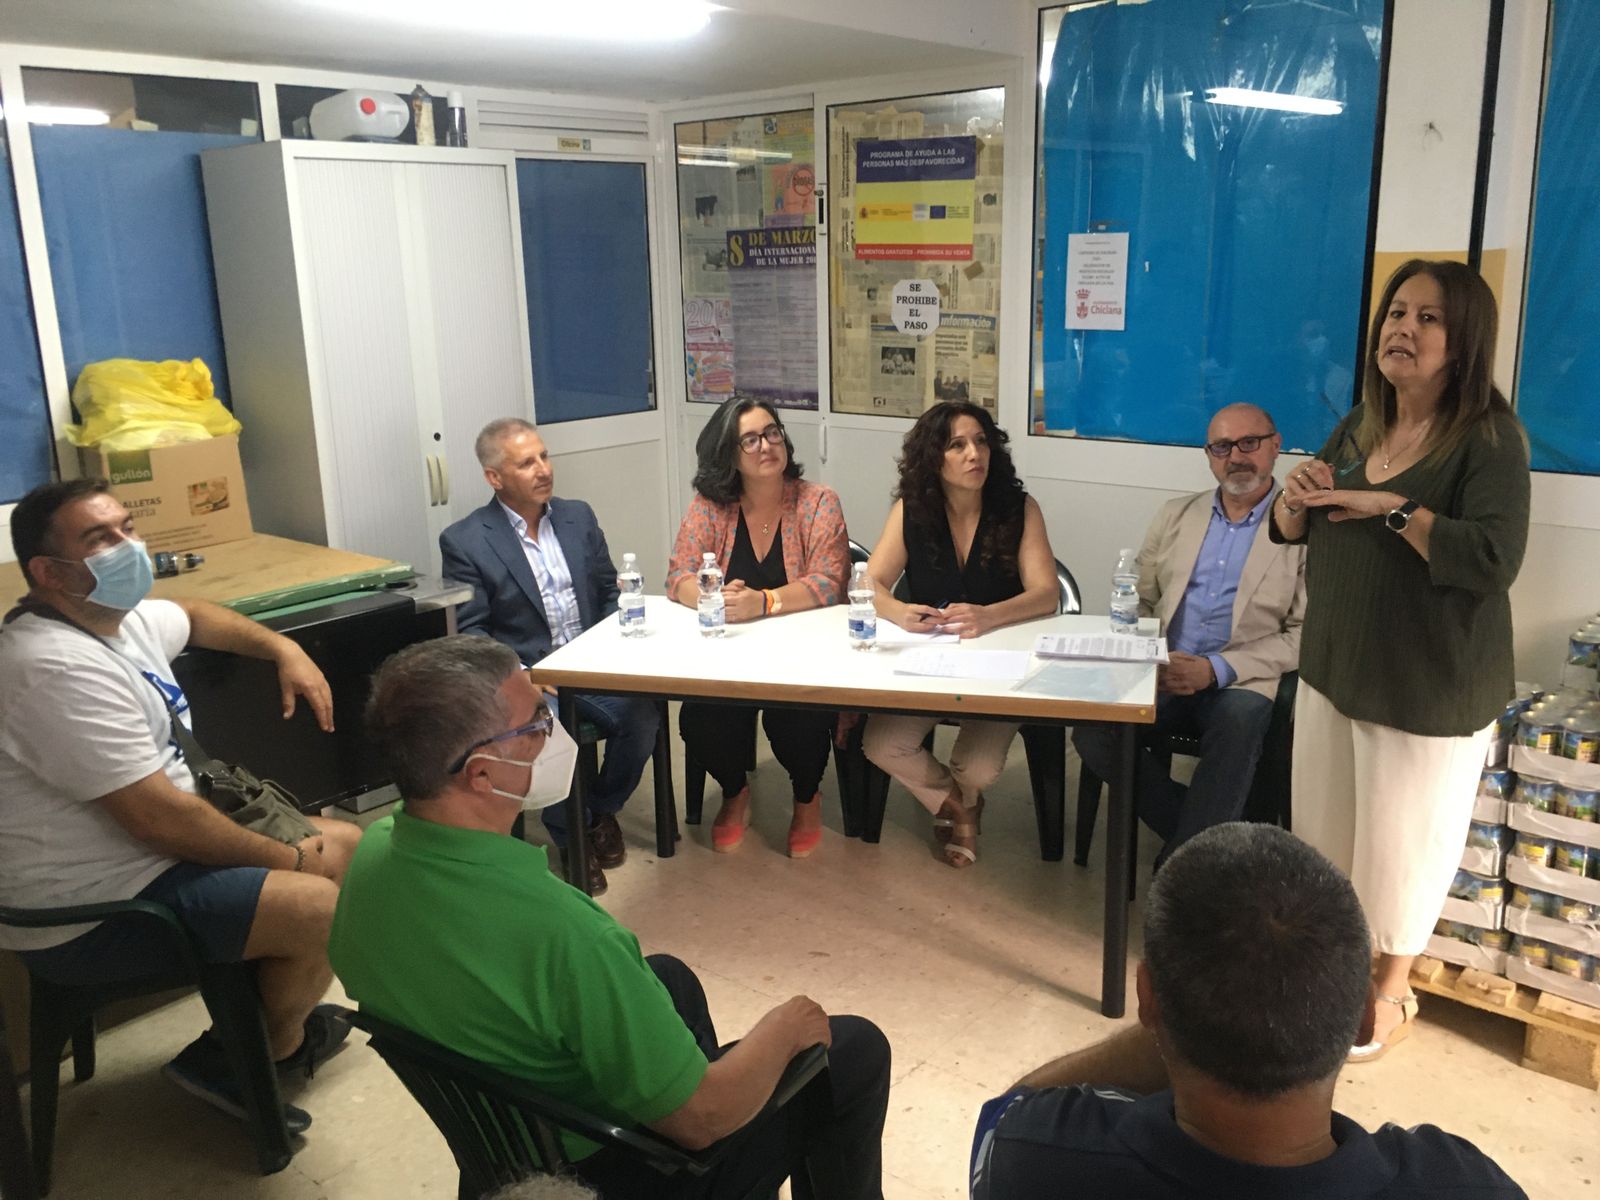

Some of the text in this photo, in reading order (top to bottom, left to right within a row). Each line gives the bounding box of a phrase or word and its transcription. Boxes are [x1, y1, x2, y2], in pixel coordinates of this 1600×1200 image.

[870, 147, 956, 160] PROGRAMA DE AYUDA A LAS
[862, 160, 895, 168] PERSONAS
[909, 156, 966, 167] DESFAVORECIDAS
[749, 231, 767, 246] DE
[729, 234, 745, 267] 8
[749, 245, 816, 257] DÍA INTERNACIONA
[756, 257, 766, 266] DE
[768, 256, 777, 265] LA
[779, 256, 804, 265] MUJER
[909, 283, 922, 292] SE
[896, 295, 938, 305] PROHIBE
[908, 308, 921, 317] EL
[1090, 304, 1122, 315] Chiclana
[904, 320, 928, 330] PASO
[940, 314, 992, 328] información
[121, 497, 162, 508] ALLETAS
